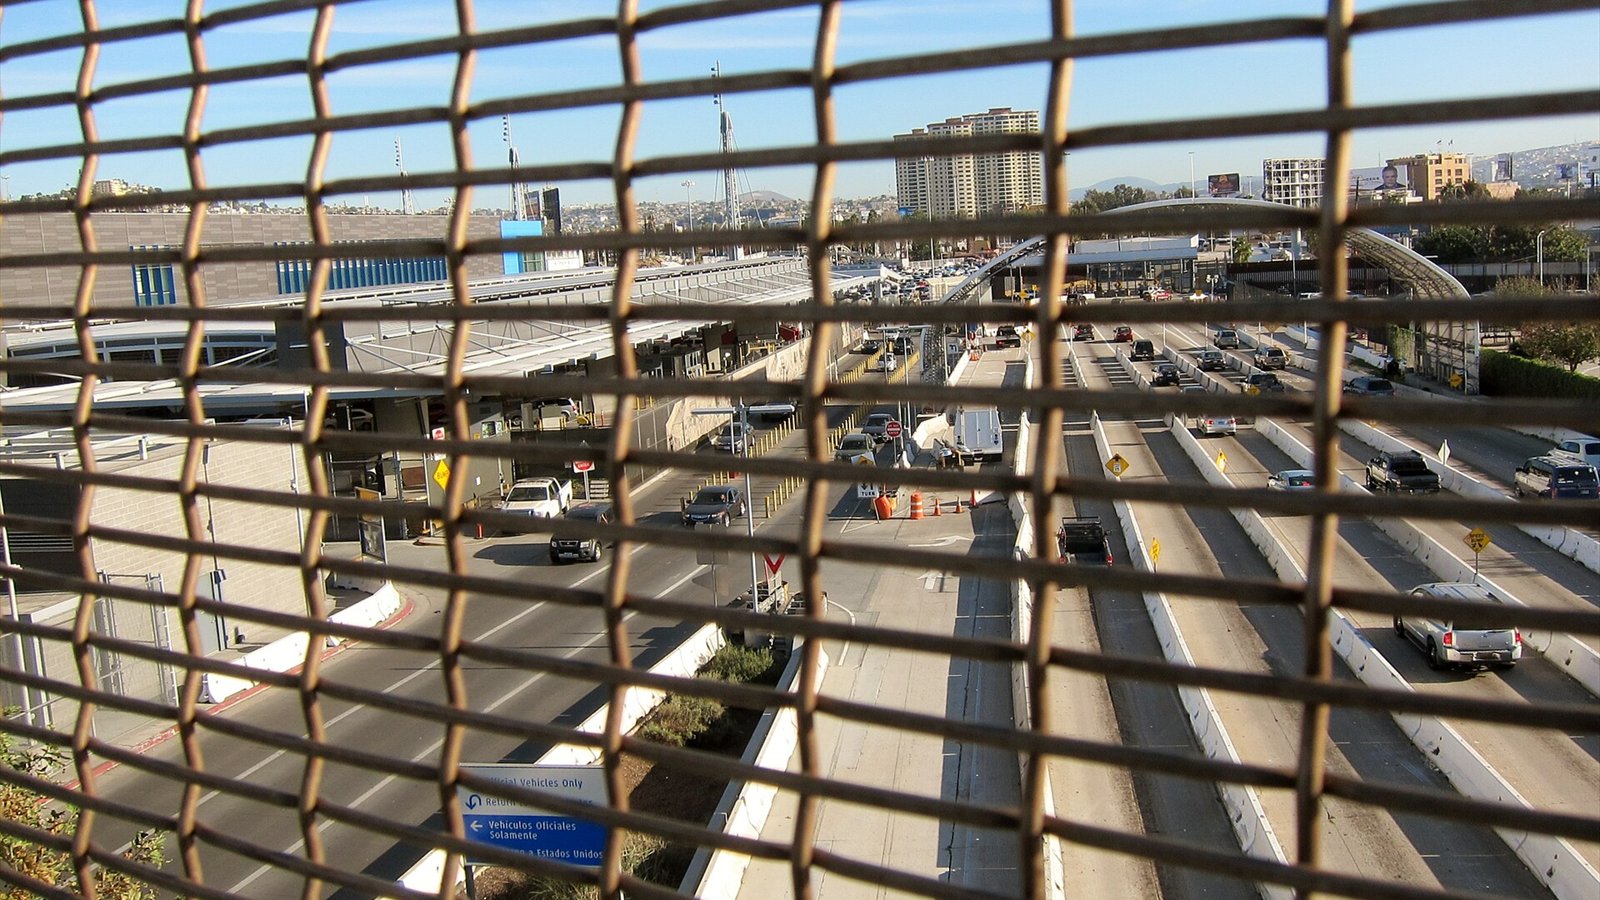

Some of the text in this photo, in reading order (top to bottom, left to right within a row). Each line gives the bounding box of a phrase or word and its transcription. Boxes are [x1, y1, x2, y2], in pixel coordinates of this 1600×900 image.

[520, 778, 559, 788] Vehicles
[562, 778, 583, 790] Only
[536, 821, 576, 831] Oficiales
[489, 831, 538, 840] Solamente
[537, 848, 570, 858] Estados
[573, 849, 604, 859] Unidos
